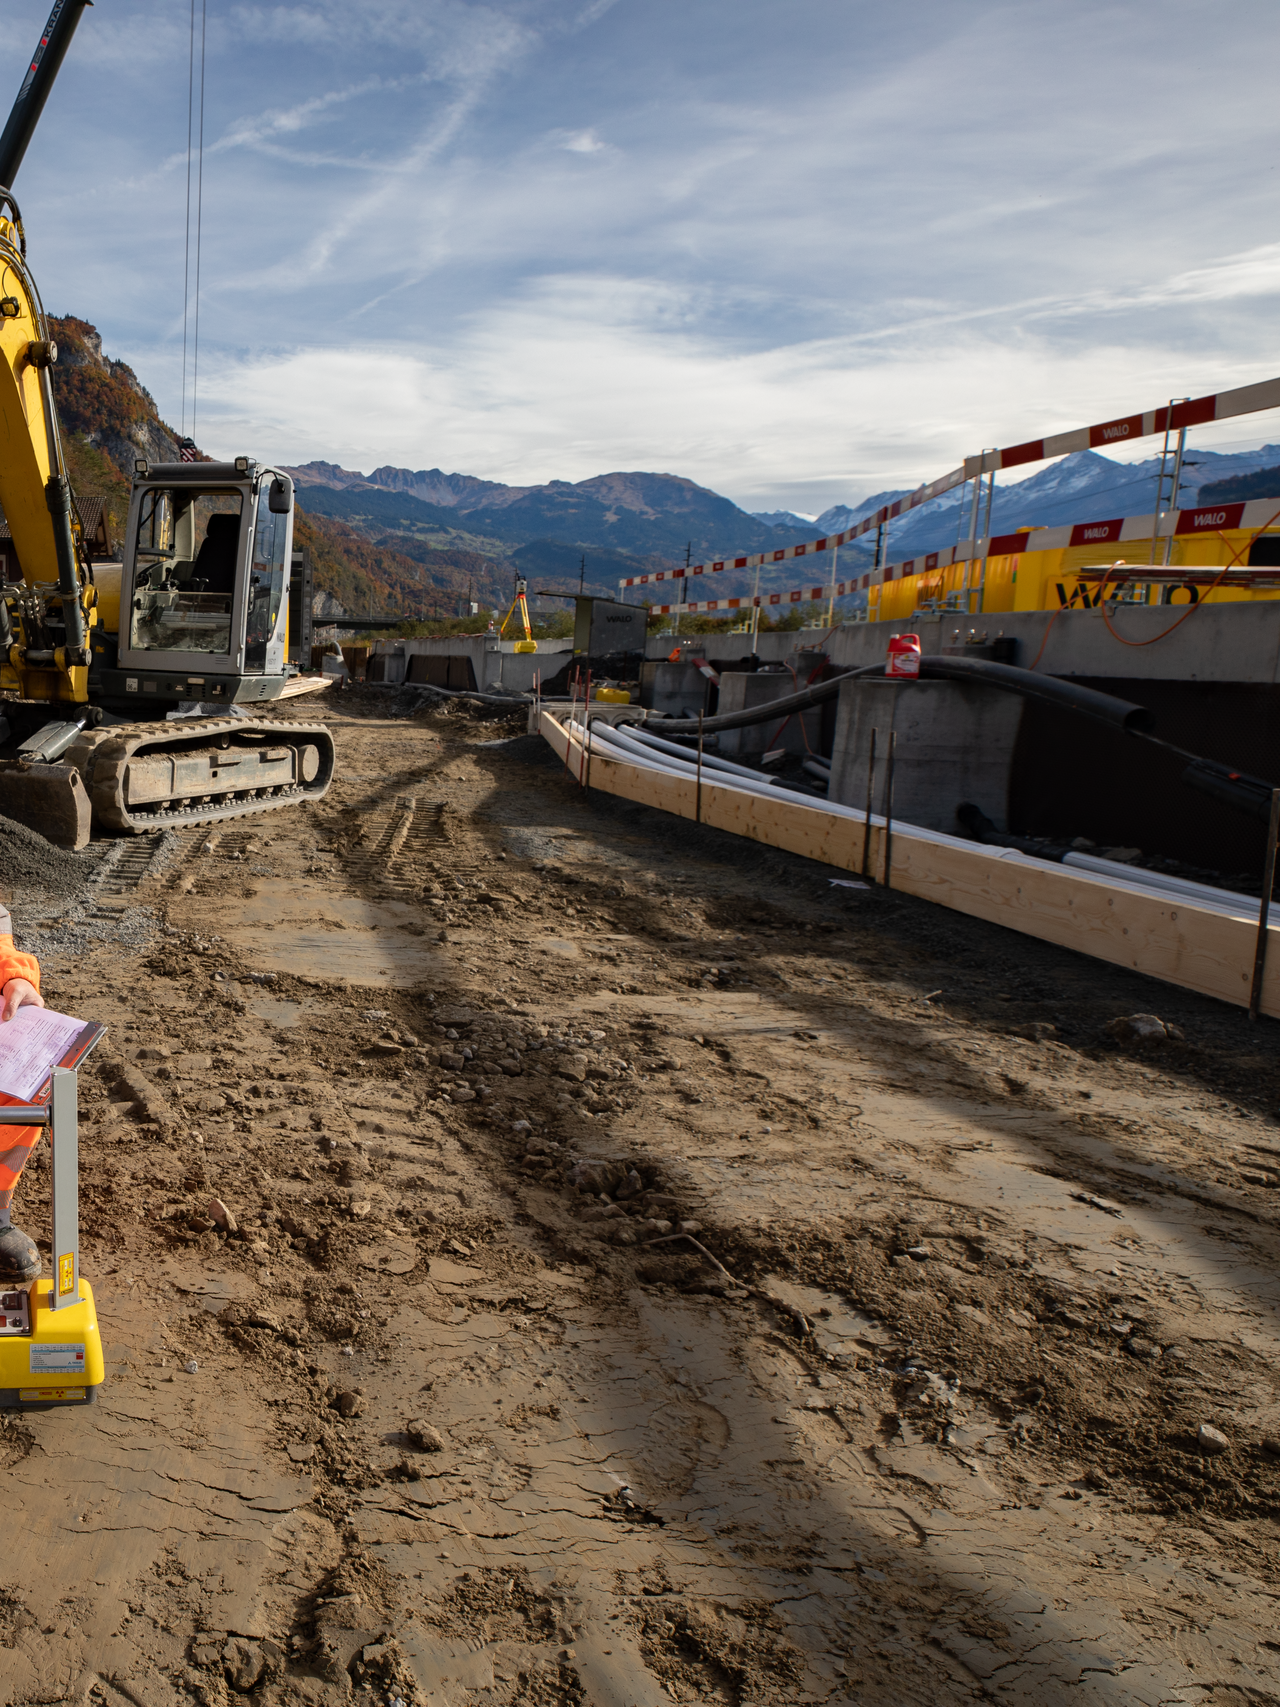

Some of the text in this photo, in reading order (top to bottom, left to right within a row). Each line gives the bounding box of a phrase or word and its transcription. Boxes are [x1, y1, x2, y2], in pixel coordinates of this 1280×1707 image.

[45, 0, 63, 37] KRAN
[1103, 424, 1129, 440] WALO
[1194, 512, 1226, 527] WALO
[1084, 526, 1109, 540] WALO
[606, 615, 633, 623] WALO
